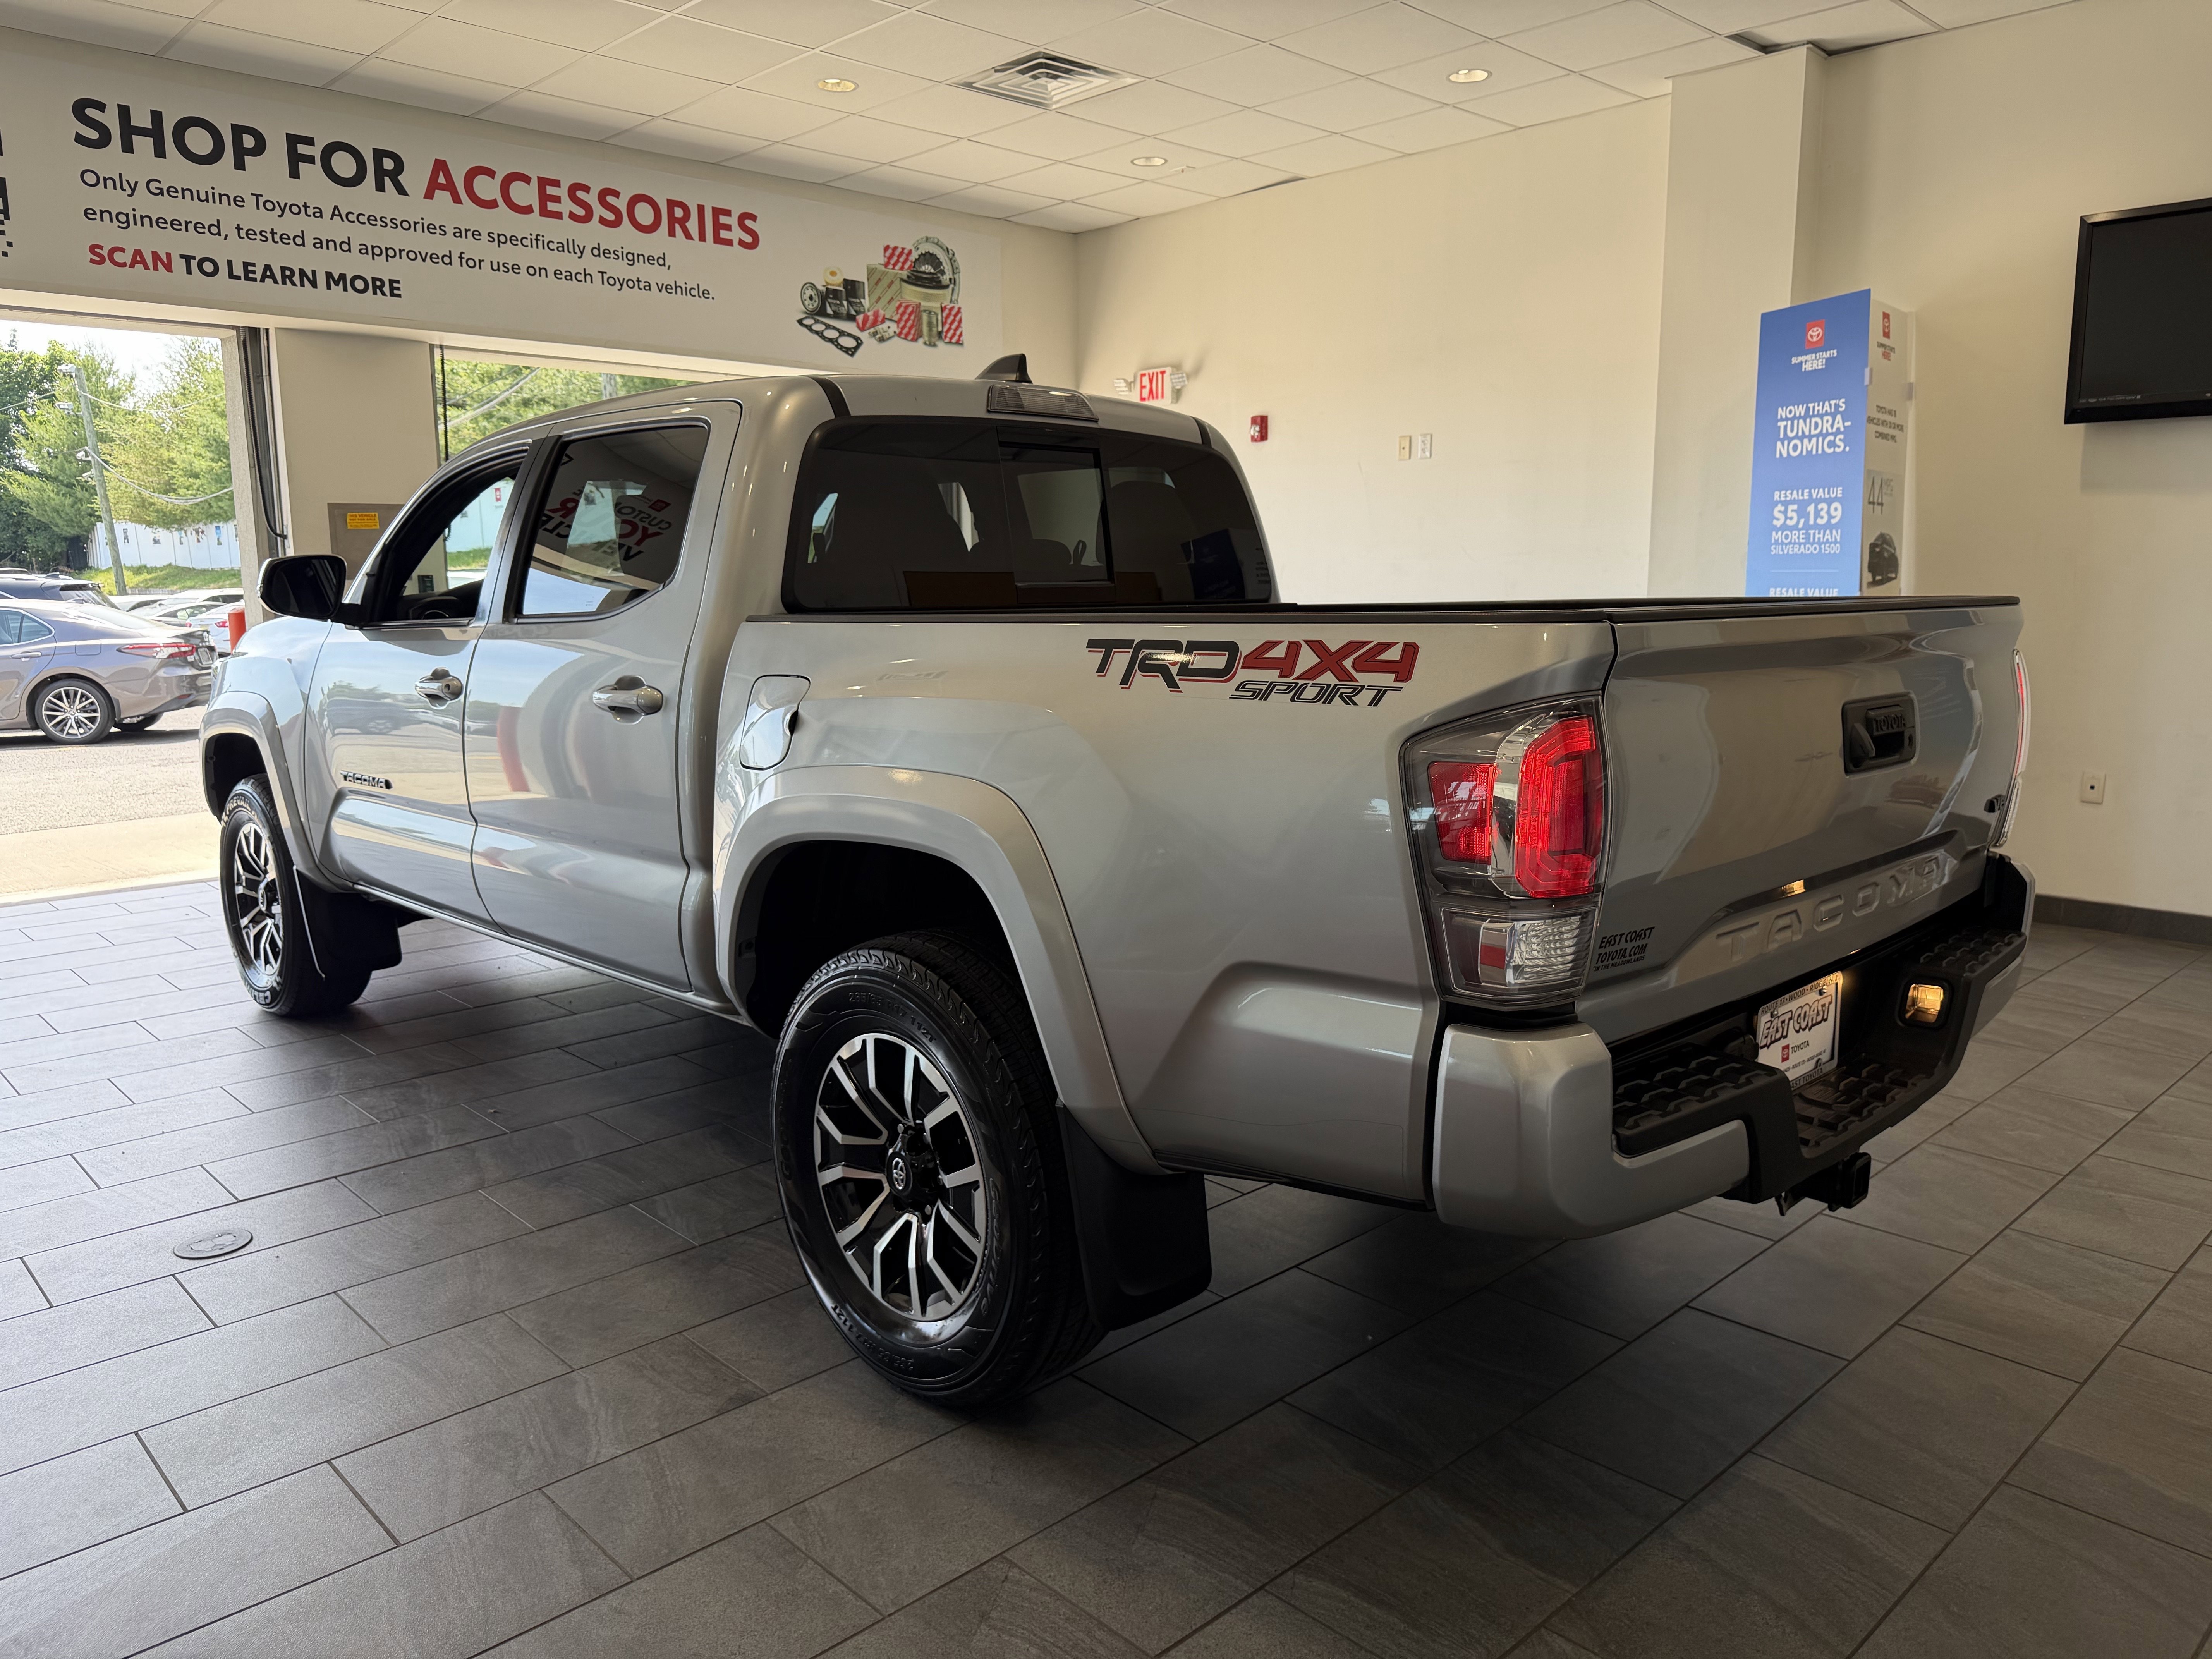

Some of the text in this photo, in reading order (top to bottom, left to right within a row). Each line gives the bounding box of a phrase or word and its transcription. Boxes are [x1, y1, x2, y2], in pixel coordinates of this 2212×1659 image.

[72, 98, 760, 250] SHOP FOR ACCESSORIES
[80, 169, 670, 270] Only Genuine Toyota Accessories are specifically designed,
[84, 208, 714, 300] engineered, tested and approved for use on each Toyota vehicle.
[89, 244, 401, 298] SCAN TO LEARN MORE
[1791, 349, 1837, 364] SUMMER STARTS
[1802, 359, 1826, 371] HERE!
[1140, 370, 1166, 402] EXIT
[1778, 398, 1845, 419] NOW THAT'S
[1778, 414, 1851, 438] TUNDRA-
[1776, 435, 1850, 458] NOMICS.
[1774, 487, 1842, 501] RESALE VALUE
[1772, 502, 1842, 528] $5,139
[1772, 529, 1841, 543] MORE THAN
[1771, 543, 1840, 555] SILVERADO 1500
[1769, 588, 1838, 597] RESALE VALUE
[1086, 639, 1420, 693] TRD 4X4
[1228, 680, 1404, 707] SPORT
[1874, 713, 1906, 732] TOYOTA
[340, 770, 386, 789] TACOMA
[1716, 854, 1941, 962] TACOMA
[1599, 927, 1655, 949] EAST COAST
[1596, 943, 1647, 964] TOYOTA.COM
[1761, 1002, 1778, 1014] ROUTE
[1788, 989, 1805, 1001] WOOD
[910, 1015, 937, 1043] 112T
[1760, 994, 1832, 1049] EAST COAST
[1791, 1040, 1809, 1054] TOYOTA
[1803, 1068, 1823, 1083] TOYOTA
